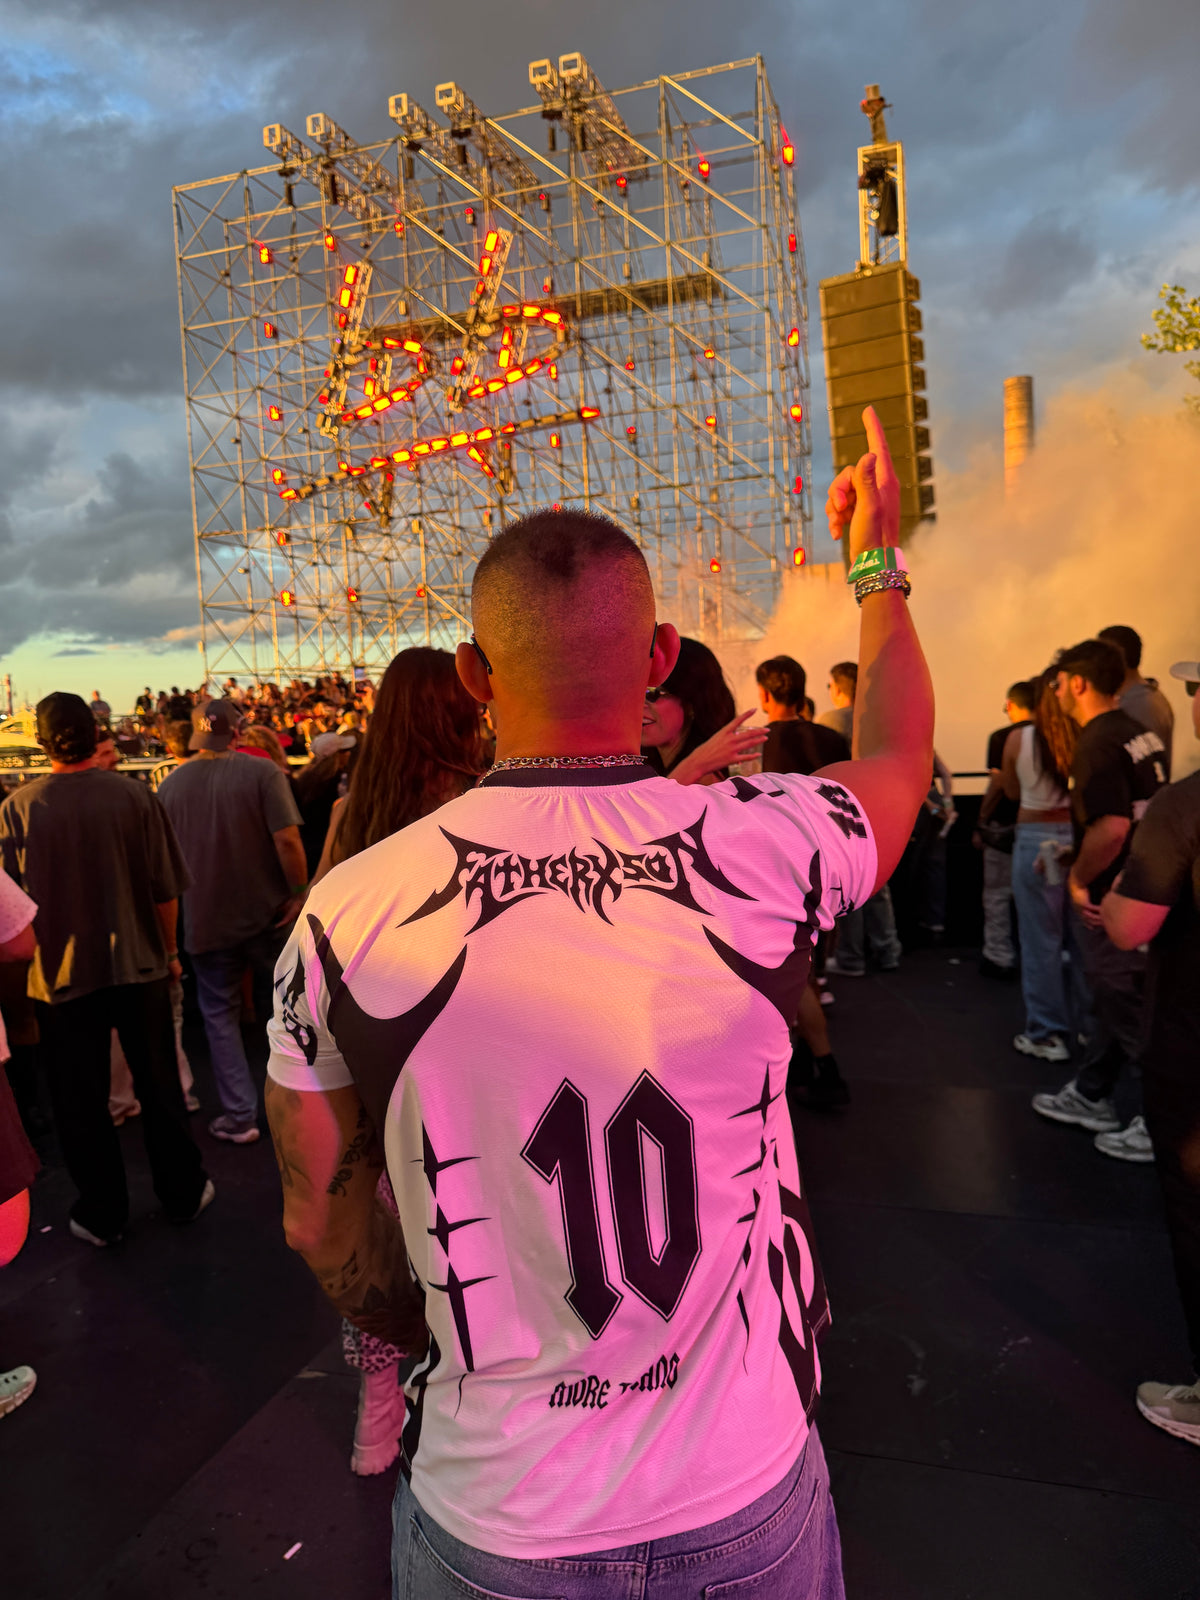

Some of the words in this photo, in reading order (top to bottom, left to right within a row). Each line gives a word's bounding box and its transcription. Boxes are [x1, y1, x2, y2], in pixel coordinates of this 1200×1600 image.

[520, 1068, 702, 1340] 10
[549, 1375, 611, 1409] MORE
[619, 1352, 681, 1395] ANO
